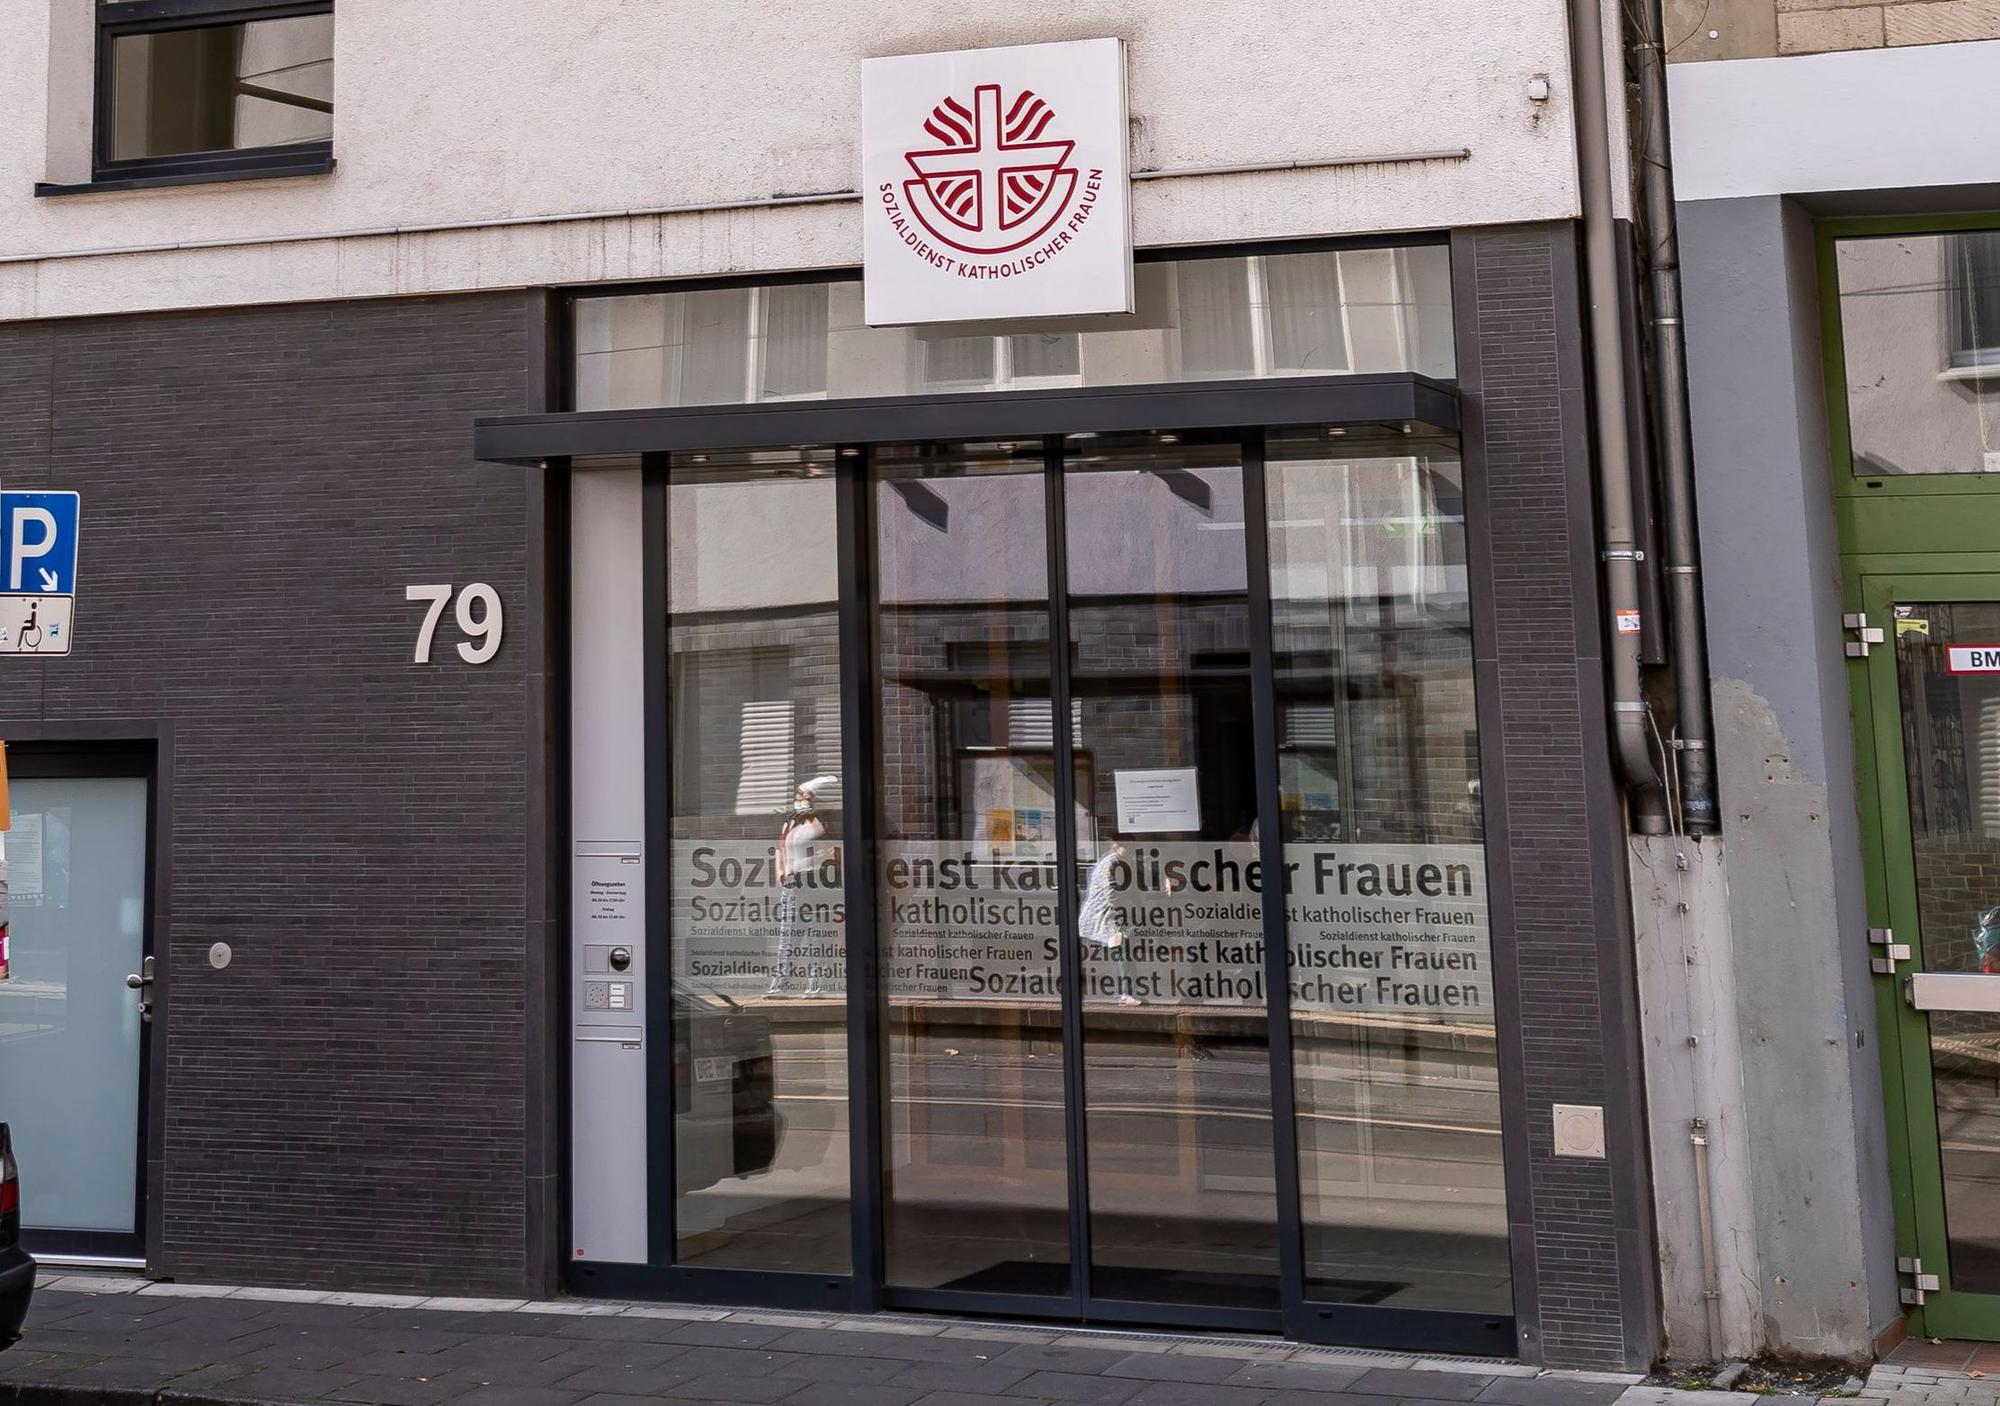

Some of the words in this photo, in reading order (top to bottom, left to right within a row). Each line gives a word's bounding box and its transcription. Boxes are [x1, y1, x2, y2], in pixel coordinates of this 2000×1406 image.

[879, 182, 955, 273] SOZIALDIENST
[957, 231, 1073, 280] KATHOLISCHER
[1067, 168, 1104, 234] FRAUEN
[10, 507, 58, 590] P
[405, 582, 503, 665] 79
[1314, 852, 1473, 897] Frauen
[1303, 905, 1411, 925] katholischer
[1415, 907, 1475, 926] Frauen
[1319, 930, 1379, 941] Sozialdienst
[1380, 931, 1441, 942] katholischer
[897, 944, 984, 960] katholischer
[986, 946, 1033, 961] Frauen
[1391, 945, 1478, 971] Frauen
[916, 963, 969, 981] Frauen
[1376, 976, 1480, 1007] Frauen
